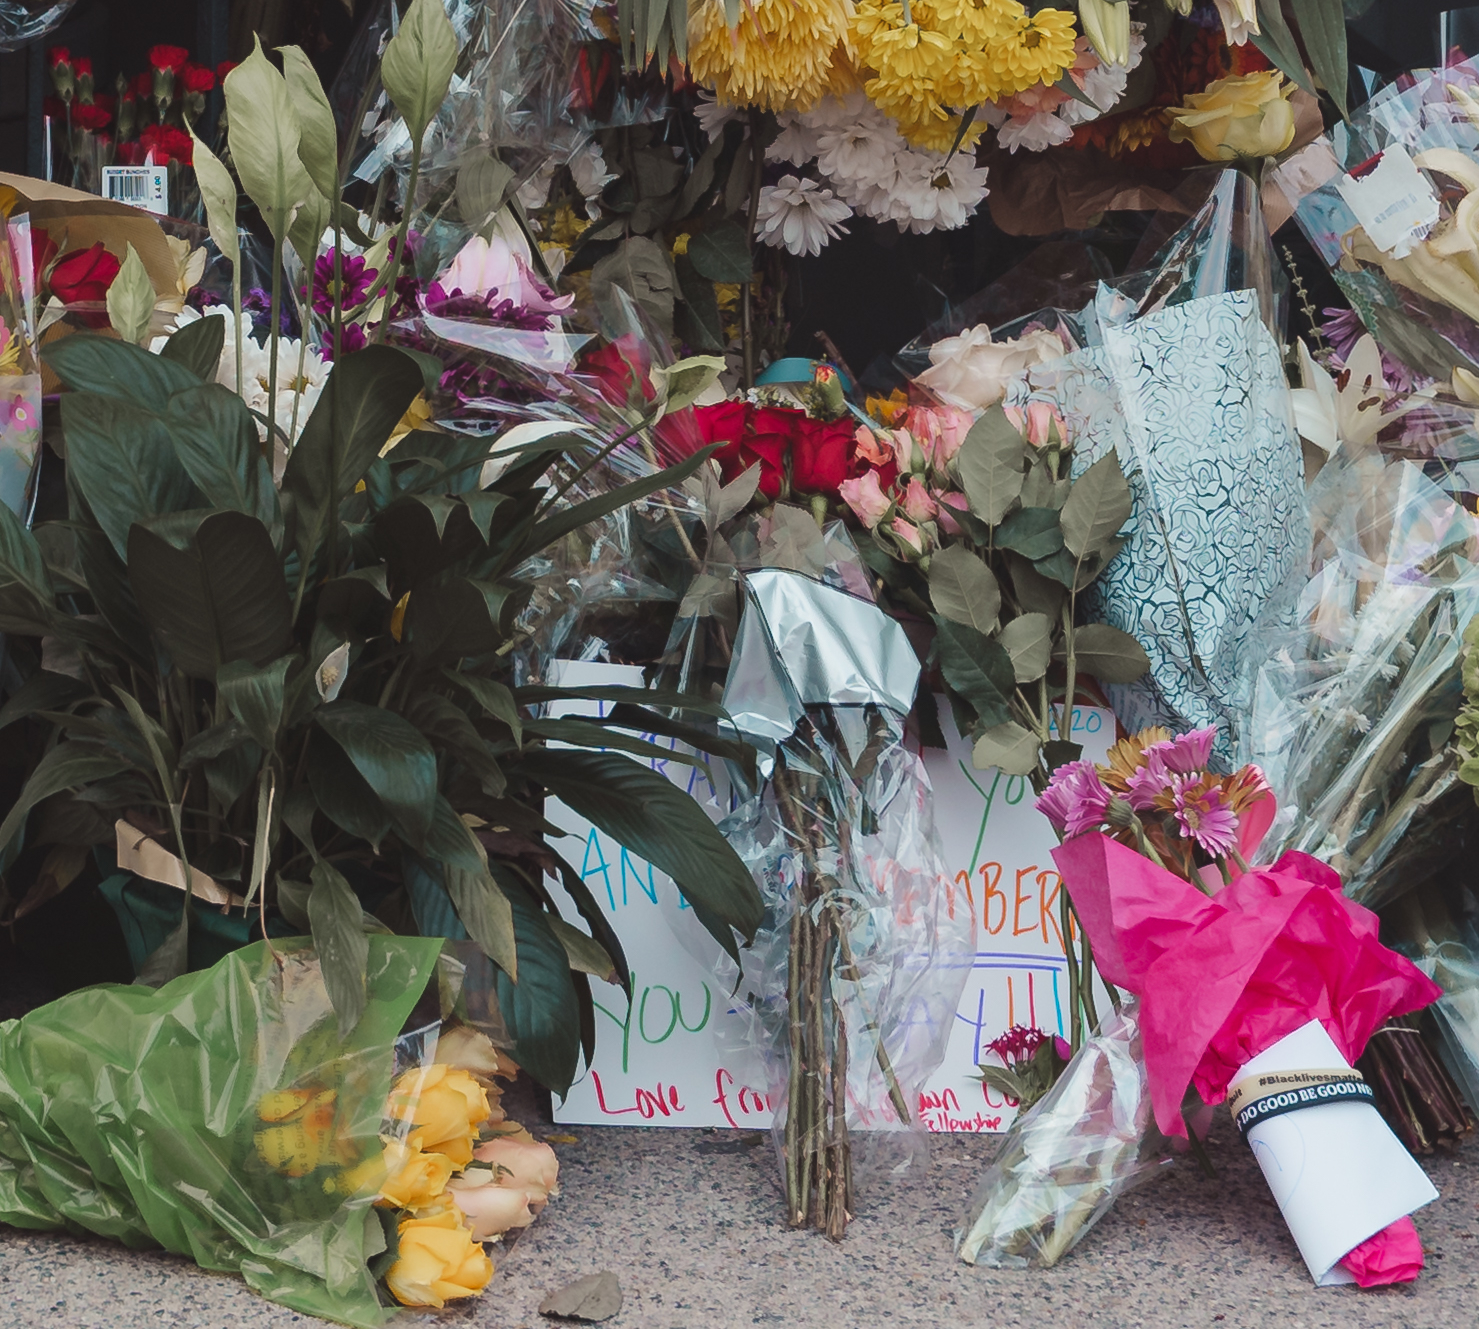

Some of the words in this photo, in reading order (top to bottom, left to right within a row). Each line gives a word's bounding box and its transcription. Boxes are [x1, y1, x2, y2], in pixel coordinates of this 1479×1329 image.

[580, 827, 692, 912] AN
[593, 971, 712, 1074] YOU
[592, 1070, 687, 1116] Love
[1240, 1105, 1258, 1125] DO
[1257, 1092, 1299, 1113] GOOD
[1299, 1089, 1318, 1102] BE
[1316, 1082, 1357, 1098] GOOD
